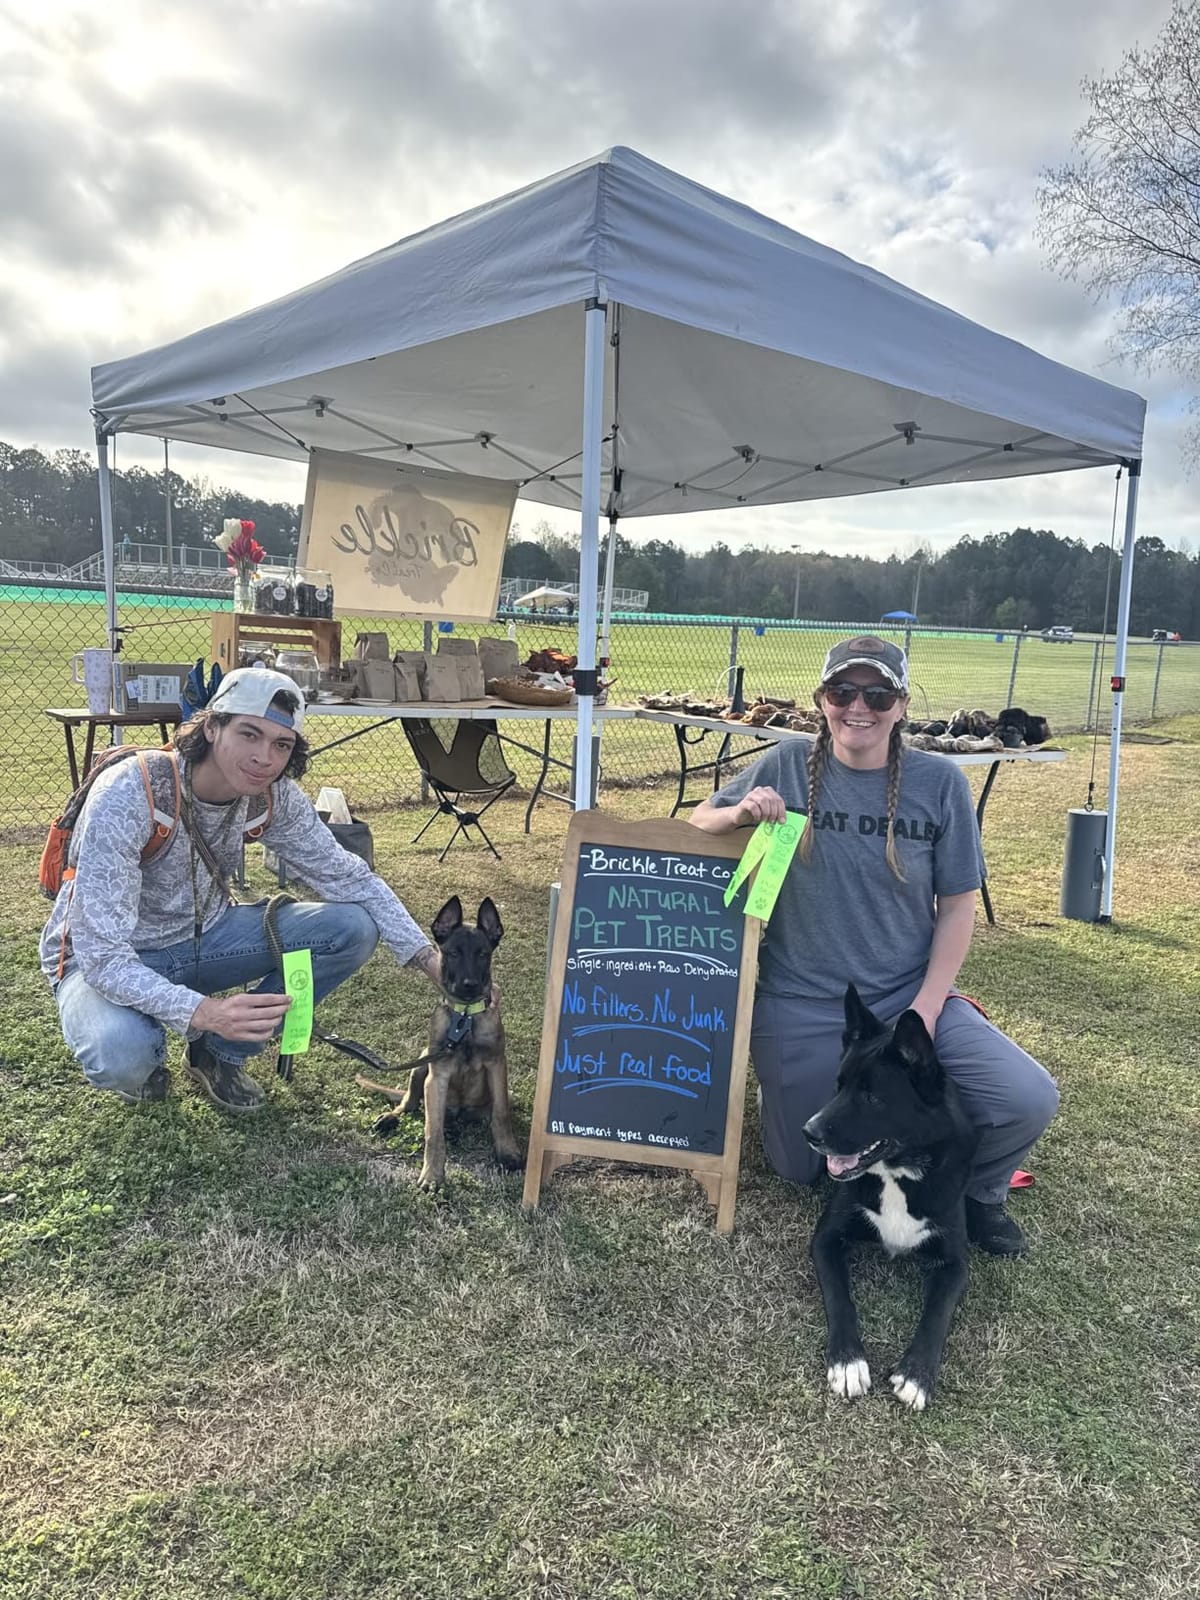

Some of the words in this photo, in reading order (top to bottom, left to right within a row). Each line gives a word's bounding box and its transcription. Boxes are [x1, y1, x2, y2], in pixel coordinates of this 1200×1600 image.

[660, 857, 708, 878] Treat
[607, 884, 720, 915] NATURAL
[574, 907, 626, 945] PET
[636, 914, 737, 952] TREATS
[657, 960, 680, 974] Raw
[683, 962, 738, 981] Dehydrated
[562, 980, 586, 1015] No
[651, 987, 677, 1024] No
[682, 994, 728, 1032] Junk.
[556, 1039, 607, 1075] Just
[619, 1052, 653, 1079] real
[661, 1055, 712, 1085] food
[551, 1120, 565, 1134] All
[617, 1128, 642, 1142] types
[648, 1133, 690, 1147] accepted
